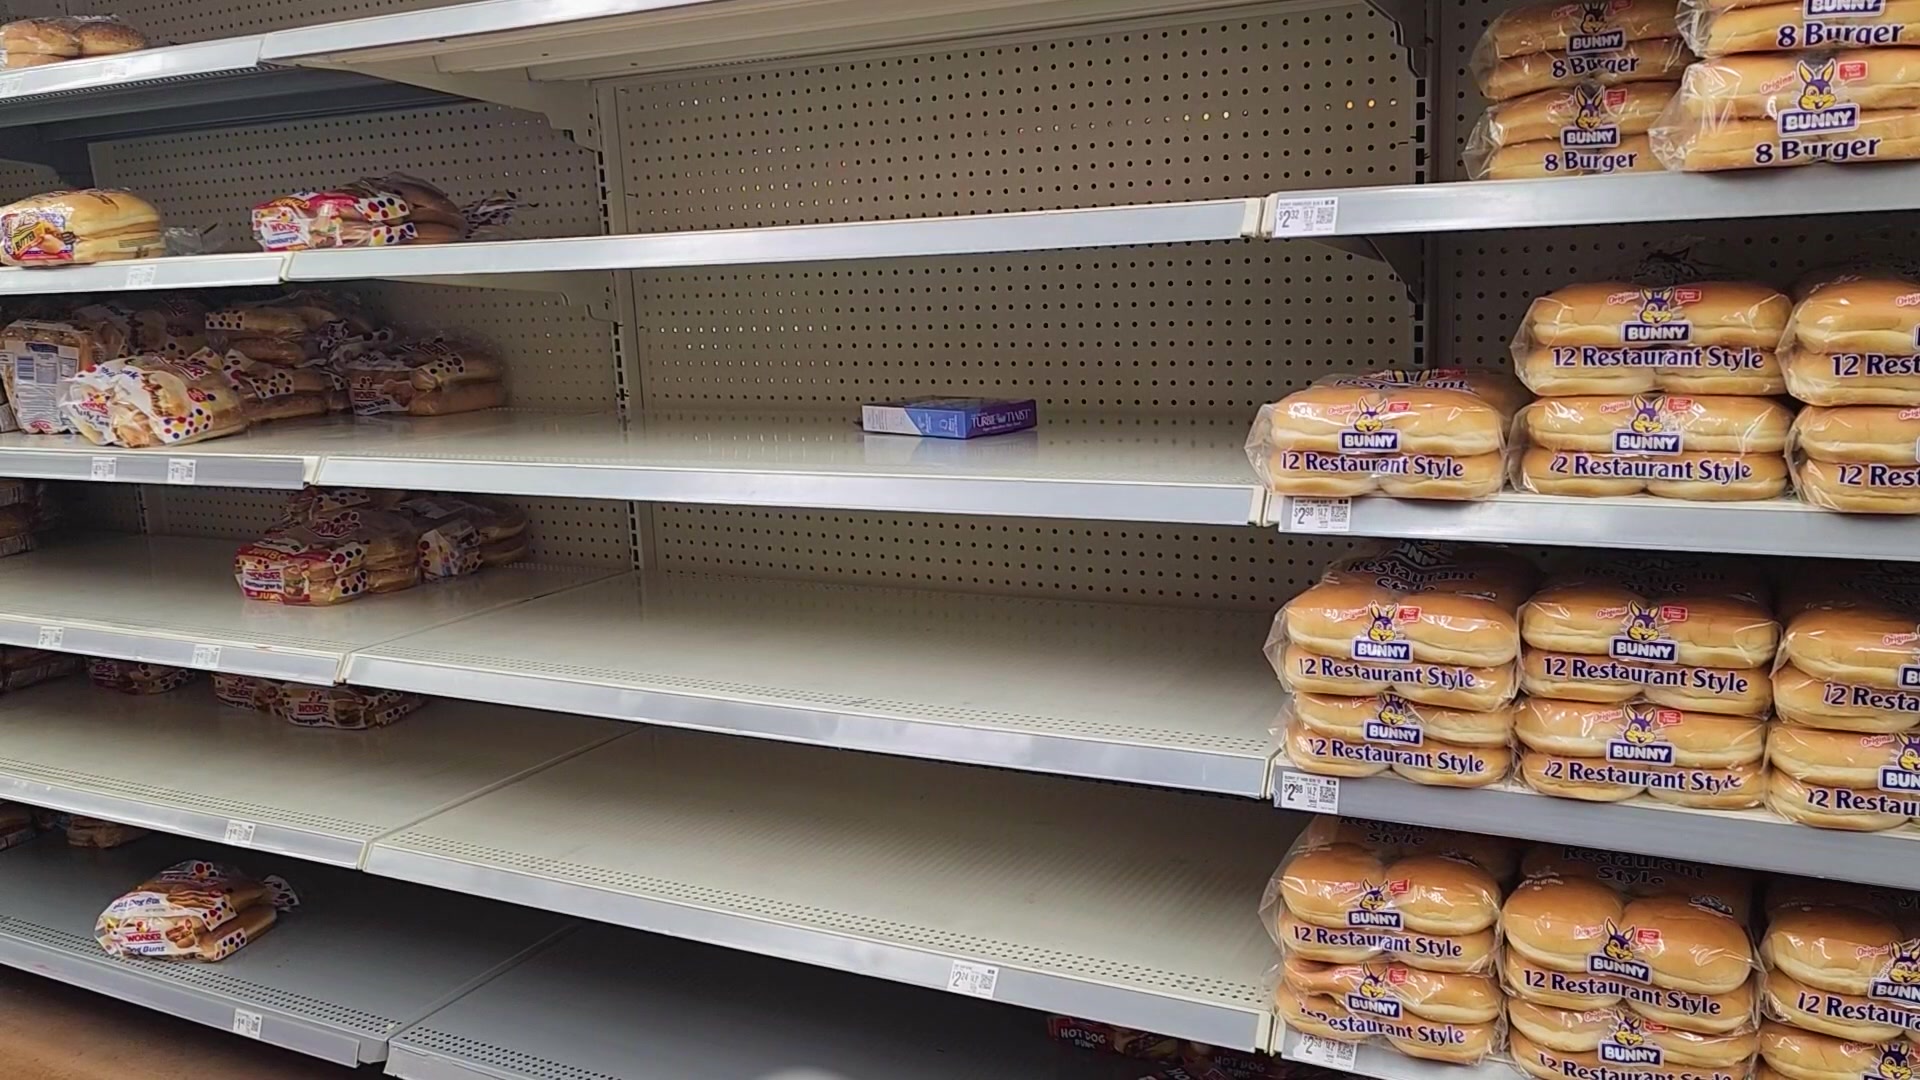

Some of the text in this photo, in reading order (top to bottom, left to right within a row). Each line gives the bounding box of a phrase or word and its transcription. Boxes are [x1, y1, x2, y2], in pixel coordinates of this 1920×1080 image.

[1572, 35, 1621, 49] BUNNY
[1778, 22, 1905, 48] 8 Burger
[1552, 56, 1640, 78] 8 Burger
[1785, 111, 1852, 131] BUNNY
[1566, 130, 1615, 144] BUNNY
[1755, 138, 1881, 164] 8 Burger
[1544, 151, 1638, 172] 8 Burger
[1627, 325, 1687, 341] BUNNY
[1552, 347, 1765, 371] 12 Restaurant Style
[1832, 355, 1860, 376] 12
[1344, 434, 1396, 448] BUNNY
[1619, 435, 1678, 450] BUNNY
[1281, 452, 1464, 480] 12 Restaurant Style
[1575, 455, 1694, 479] Restaurant
[1698, 459, 1753, 484] Style
[1838, 465, 1862, 486] 12
[1357, 642, 1408, 658] BUNNY
[1616, 641, 1673, 659] BUNNY
[1299, 658, 1476, 690] 12 Restaurant Style
[1544, 657, 1749, 695] 12 Restaurant Style
[1824, 684, 1847, 706] 12
[1369, 726, 1417, 743] BUNNY
[1309, 739, 1485, 775] 12 Restaurant Style
[1613, 745, 1669, 761] BUNNY
[1569, 762, 1686, 791] Restaurant
[1367, 832, 1426, 848] Style
[1597, 867, 1666, 885] Style
[1350, 912, 1398, 926] BUNNY
[126, 933, 162, 943] WONDER
[1293, 925, 1463, 958] 12 Restaurant Style
[142, 944, 166, 954] Buns
[1592, 959, 1647, 980] BUNNY
[1523, 969, 1722, 1017] 12 Restaurant Style
[1797, 991, 1821, 1014] 12
[1350, 998, 1398, 1015] BUNNY
[1060, 1027, 1107, 1045] HOT DOG
[1417, 1024, 1466, 1048] Style
[1538, 1053, 1558, 1072] 12
[1604, 1046, 1658, 1063] BUNNY
